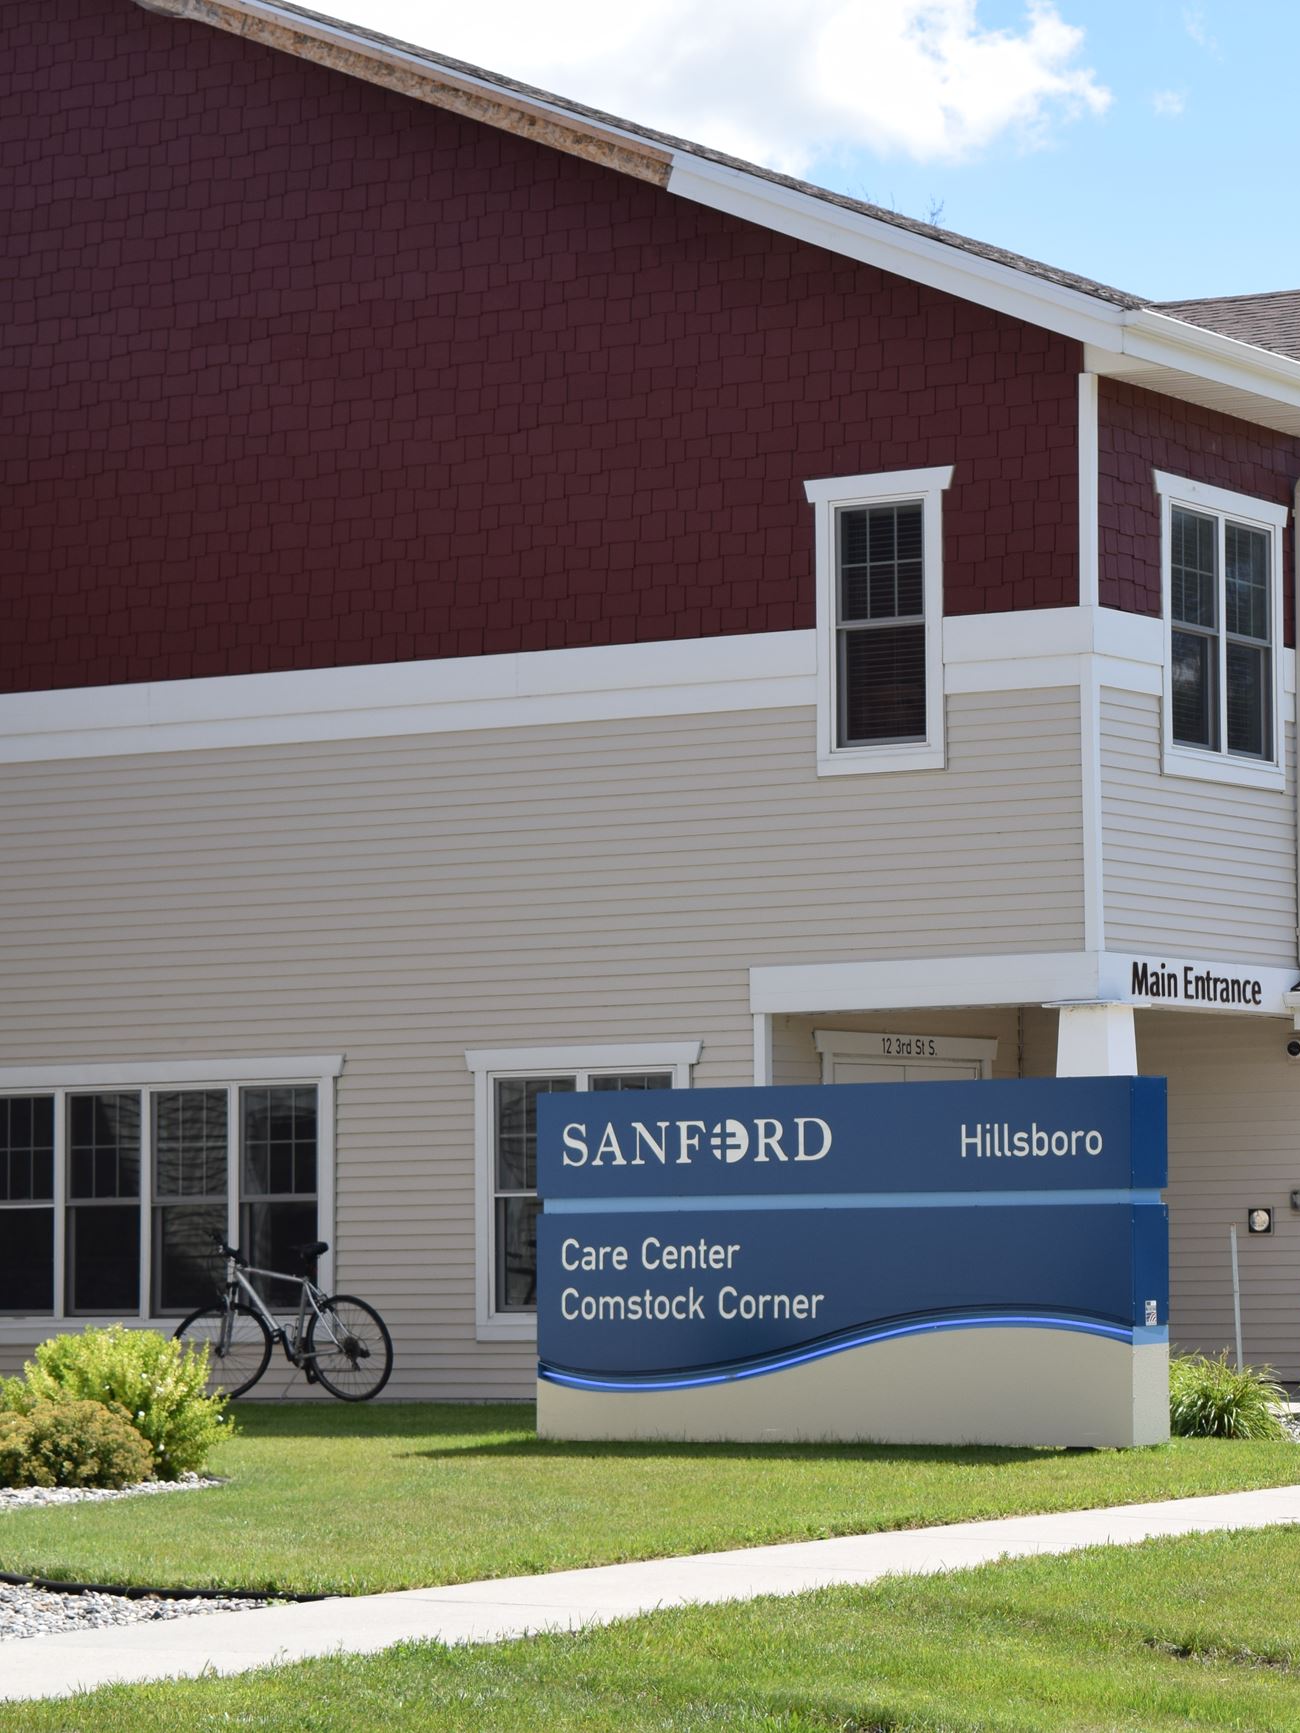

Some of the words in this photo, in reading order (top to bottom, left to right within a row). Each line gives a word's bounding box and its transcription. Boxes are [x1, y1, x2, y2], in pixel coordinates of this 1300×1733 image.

[1131, 961, 1178, 998] Main
[1183, 965, 1262, 1006] Entrance
[882, 1038, 892, 1055] 12
[895, 1038, 912, 1055] 3rd
[915, 1039, 925, 1056] St
[562, 1117, 833, 1167] SANFORD
[961, 1122, 1103, 1158] Hillsboro
[561, 1238, 628, 1271] Care
[641, 1236, 741, 1270] Center
[561, 1286, 705, 1321] Comstock
[718, 1285, 825, 1320] Corner
